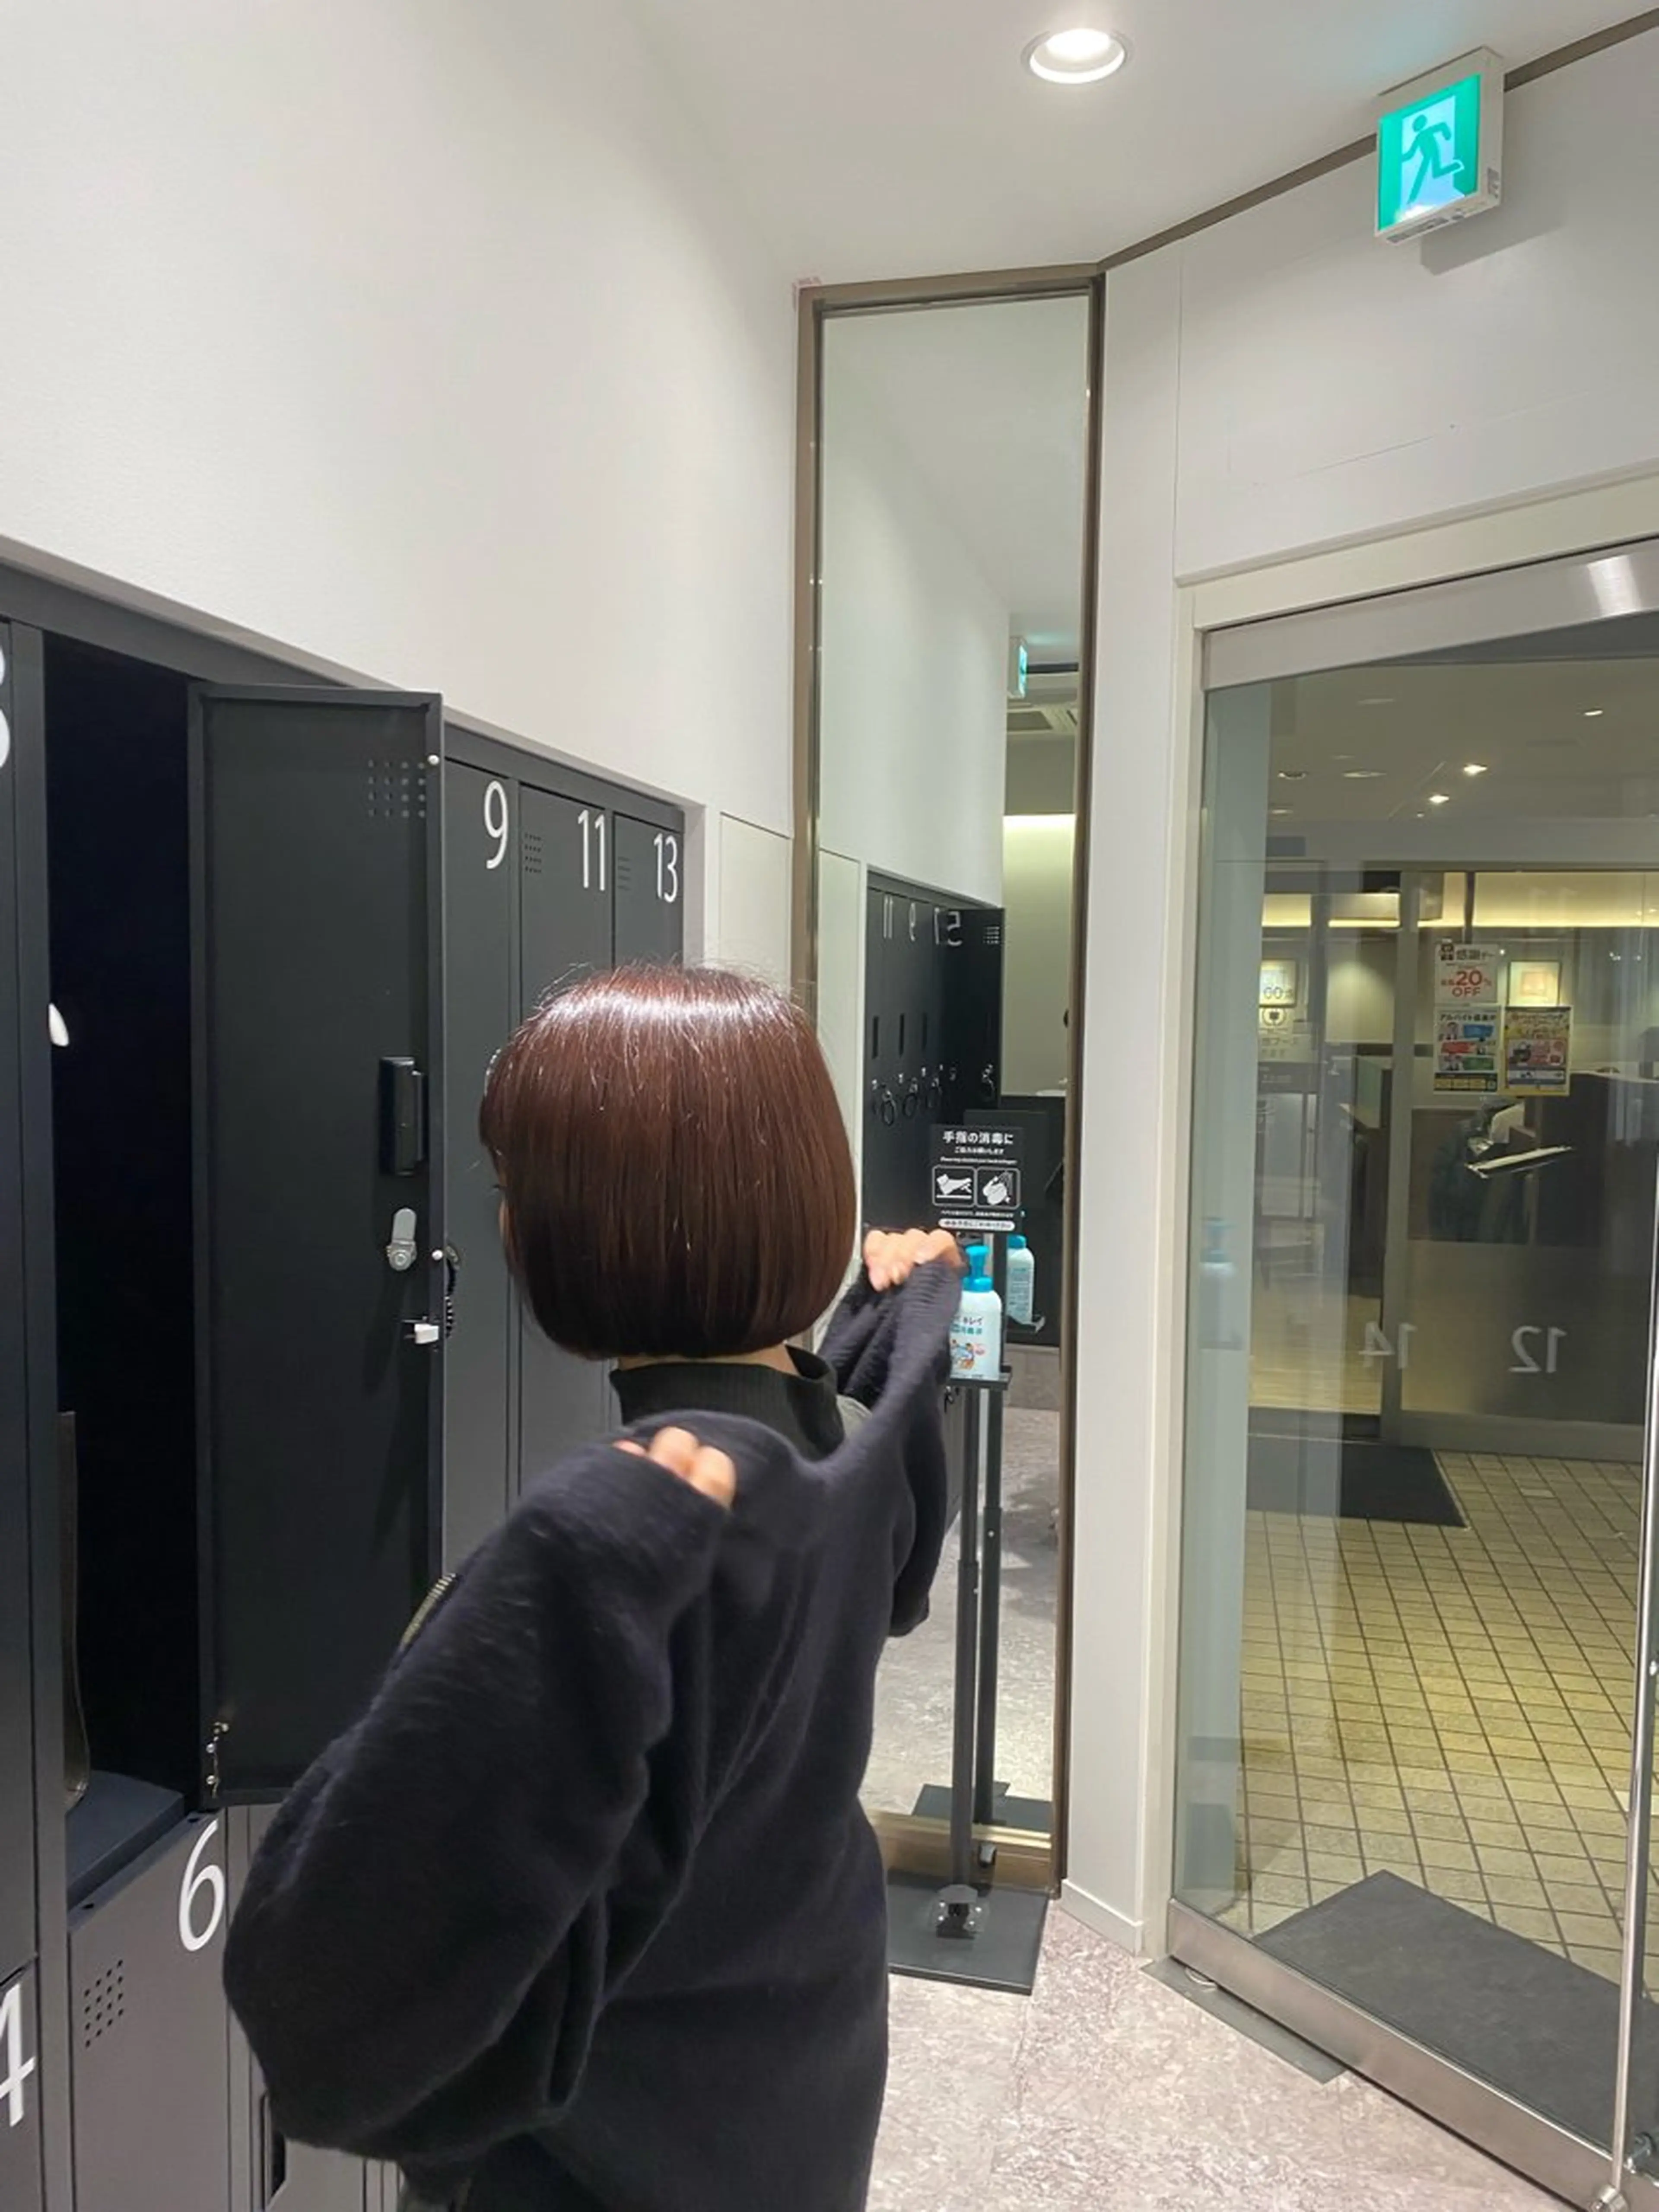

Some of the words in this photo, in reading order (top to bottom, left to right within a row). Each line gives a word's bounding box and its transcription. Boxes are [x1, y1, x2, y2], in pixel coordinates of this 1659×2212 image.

[484, 780, 509, 869] 9
[577, 809, 606, 891] 11
[653, 833, 679, 903] 13
[1452, 986, 1481, 998] OFF
[942, 1130, 1014, 1145] 手指の消毒に
[178, 1821, 225, 1951] 6
[0, 1982, 35, 2127] 4
